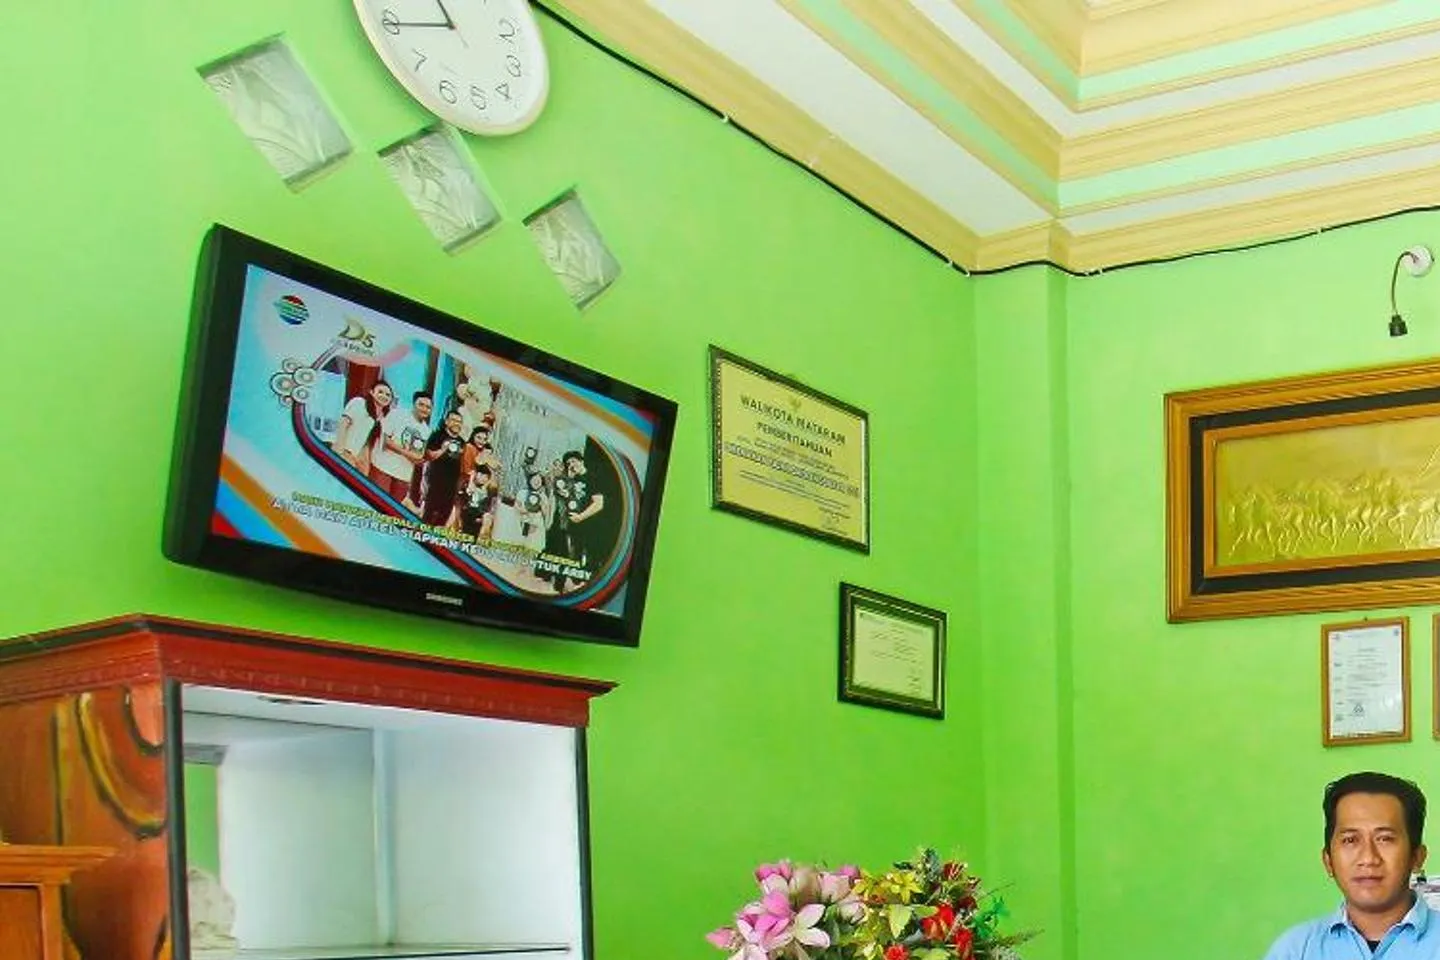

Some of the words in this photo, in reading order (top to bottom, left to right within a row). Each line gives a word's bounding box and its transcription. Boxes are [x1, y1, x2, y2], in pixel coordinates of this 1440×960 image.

[439, 80, 458, 104] 6
[739, 394, 794, 424] WALIKOTA
[795, 416, 847, 446] MATARAM
[400, 528, 460, 550] SIAPKAN
